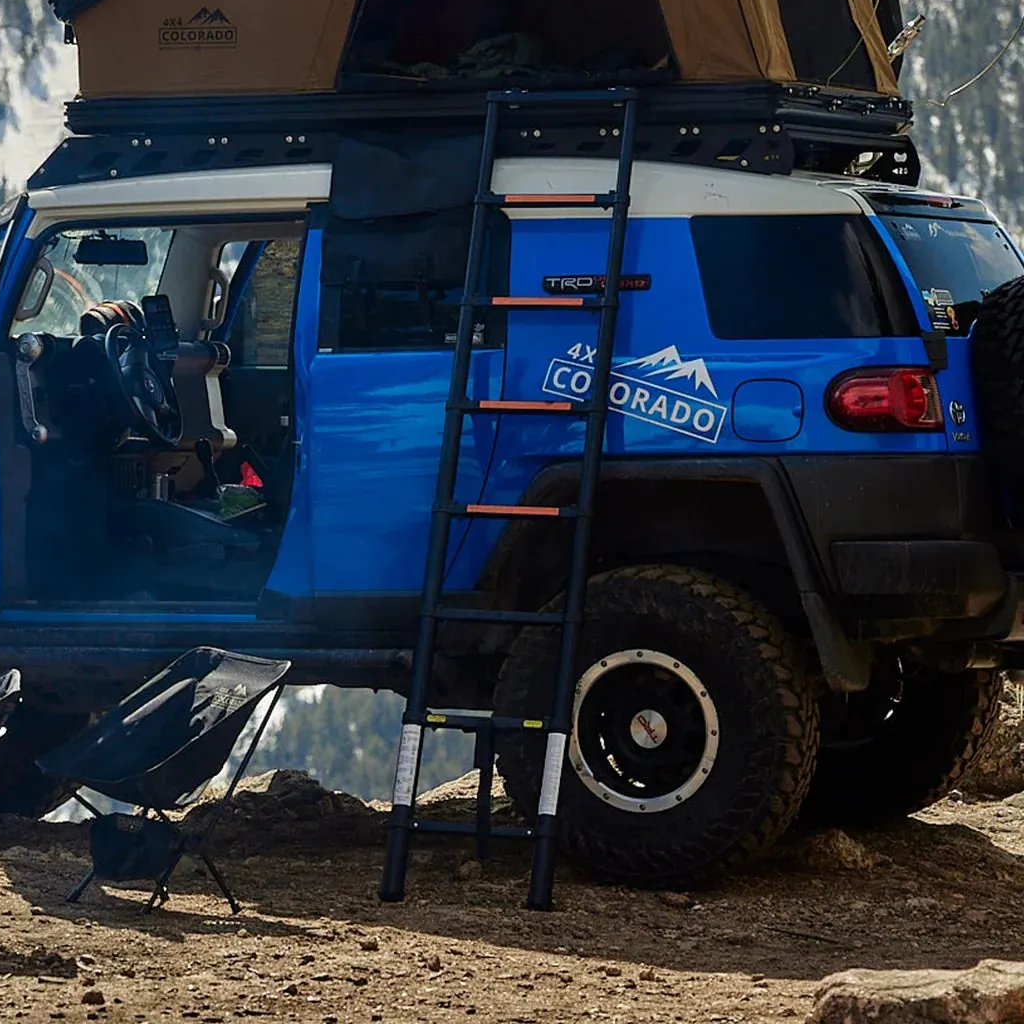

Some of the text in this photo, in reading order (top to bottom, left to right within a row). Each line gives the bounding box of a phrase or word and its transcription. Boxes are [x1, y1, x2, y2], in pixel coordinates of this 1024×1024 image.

[161, 30, 234, 41] COLORADO
[546, 277, 593, 291] TRD
[567, 342, 598, 363] 4X
[552, 366, 716, 433] COORADO
